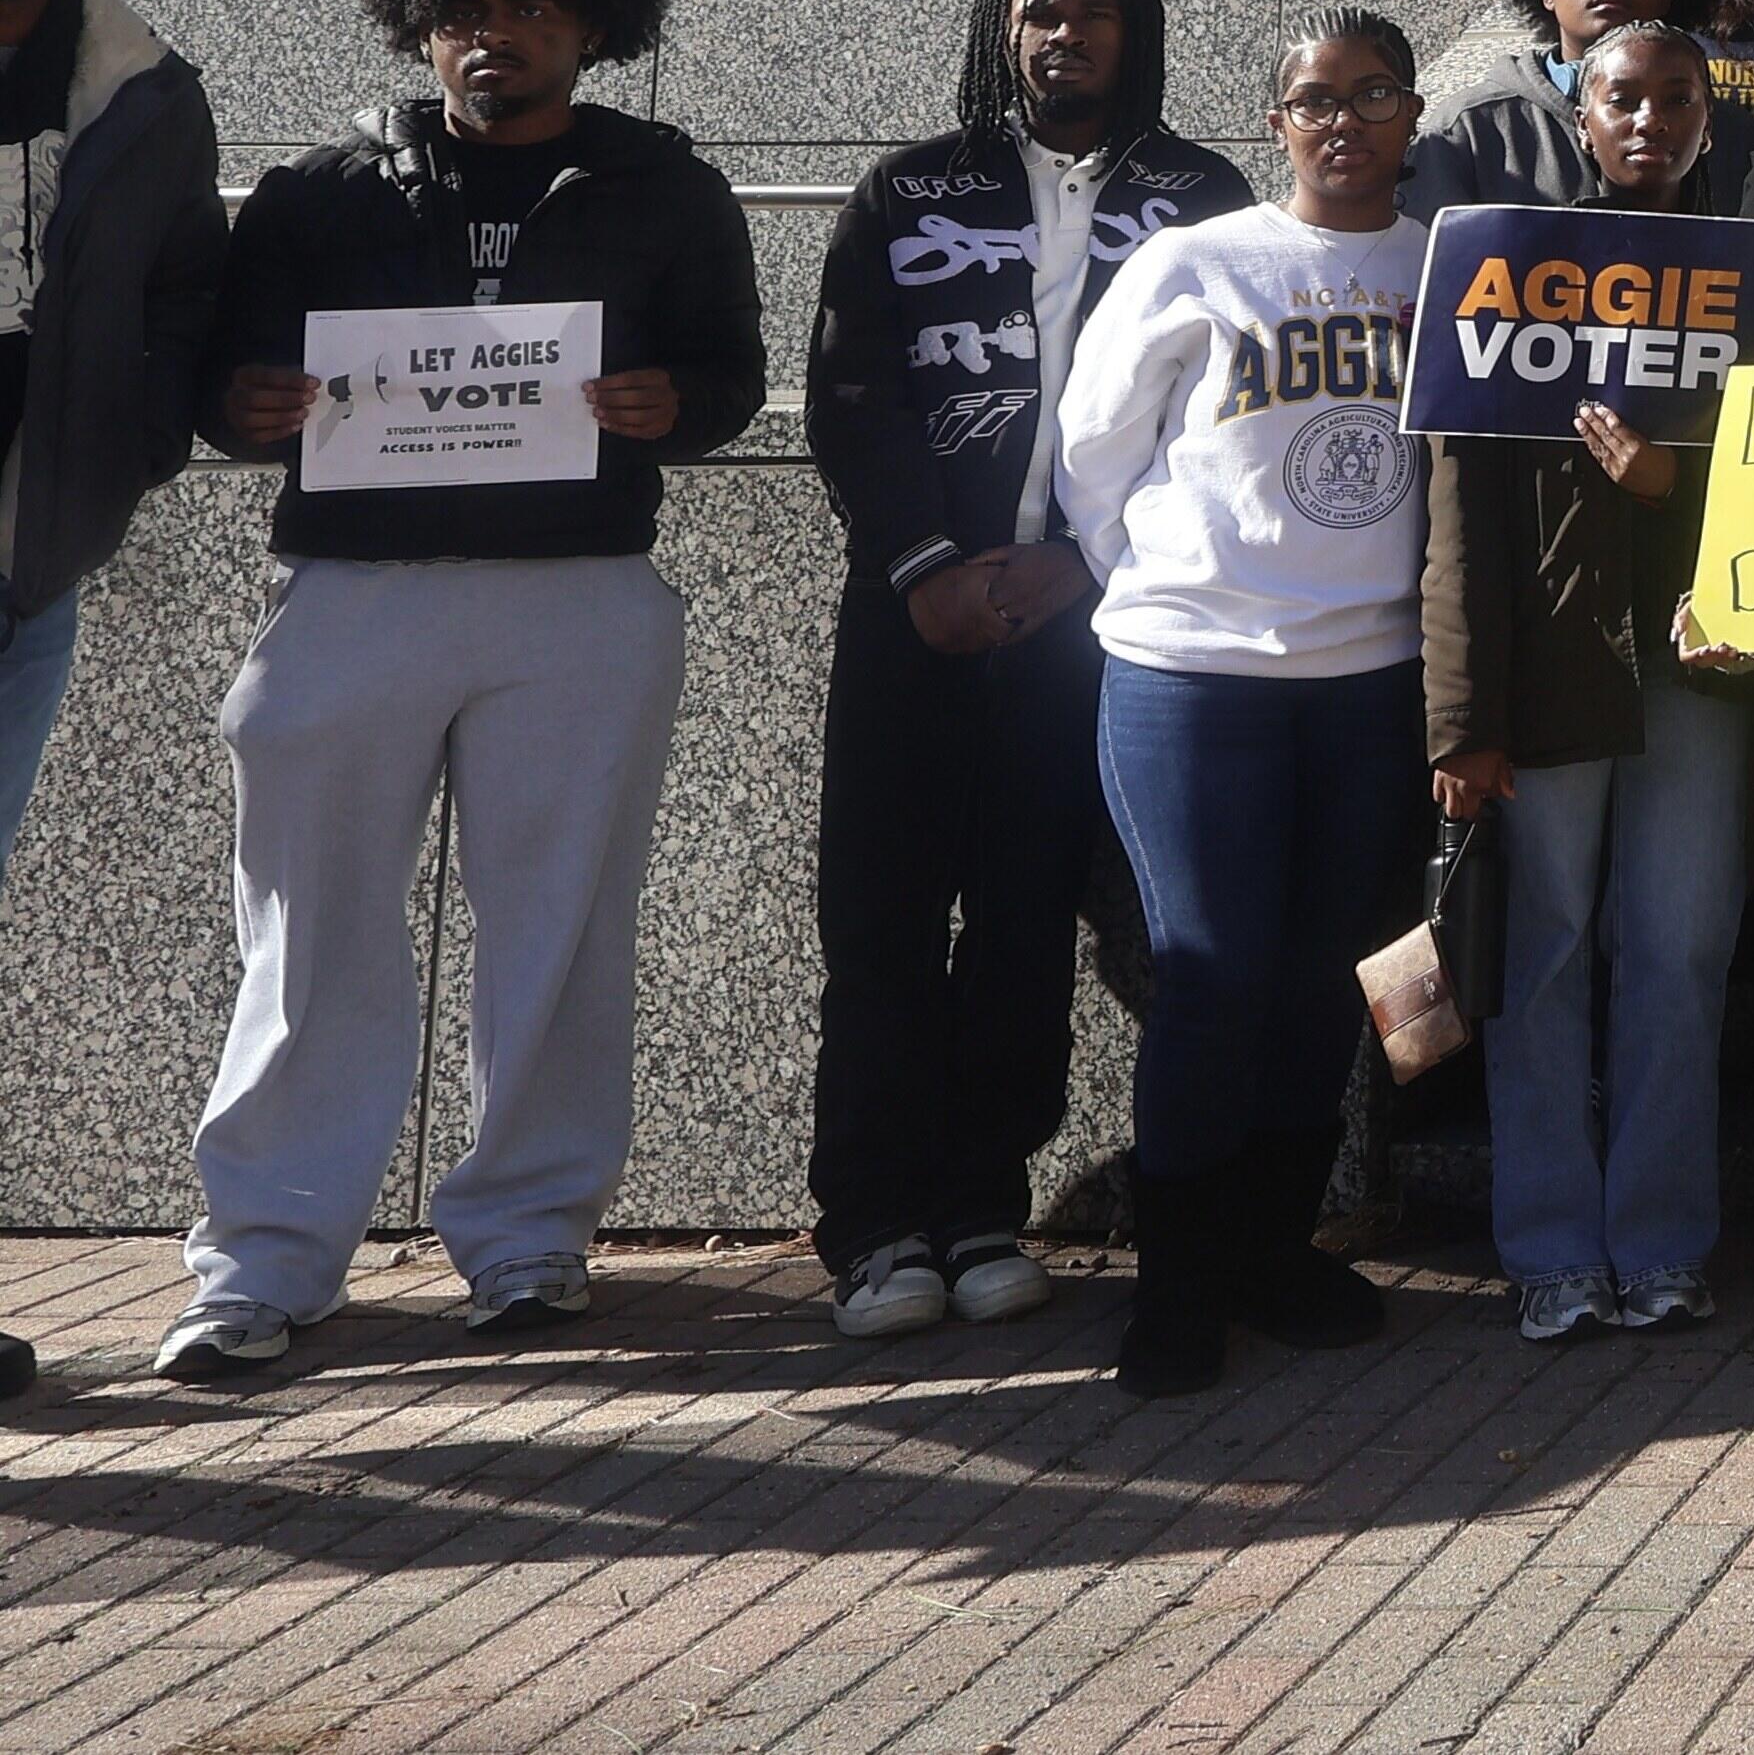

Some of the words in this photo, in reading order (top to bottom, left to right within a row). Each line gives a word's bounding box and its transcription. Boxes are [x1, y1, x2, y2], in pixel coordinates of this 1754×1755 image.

[1292, 287, 1335, 308] NC
[1351, 288, 1408, 308] A&T
[1455, 257, 1742, 330] AGGIE
[410, 347, 456, 374] LET
[470, 339, 560, 370] AGGIES
[1213, 311, 1407, 428] AGGI
[1455, 319, 1739, 391] VOTER
[418, 380, 542, 413] VOTE
[386, 426, 433, 436] STUDENT
[435, 424, 473, 434] VOICES
[475, 422, 516, 432] MATTER
[1297, 424, 1327, 462] CAROLINA
[1328, 413, 1391, 431] AGRICULTURAL
[379, 442, 434, 454] ACCESS
[441, 442, 455, 452] IS
[462, 439, 522, 450] POWER!!
[1308, 500, 1332, 517] STATE
[1333, 501, 1386, 520] UNIVERSITY
